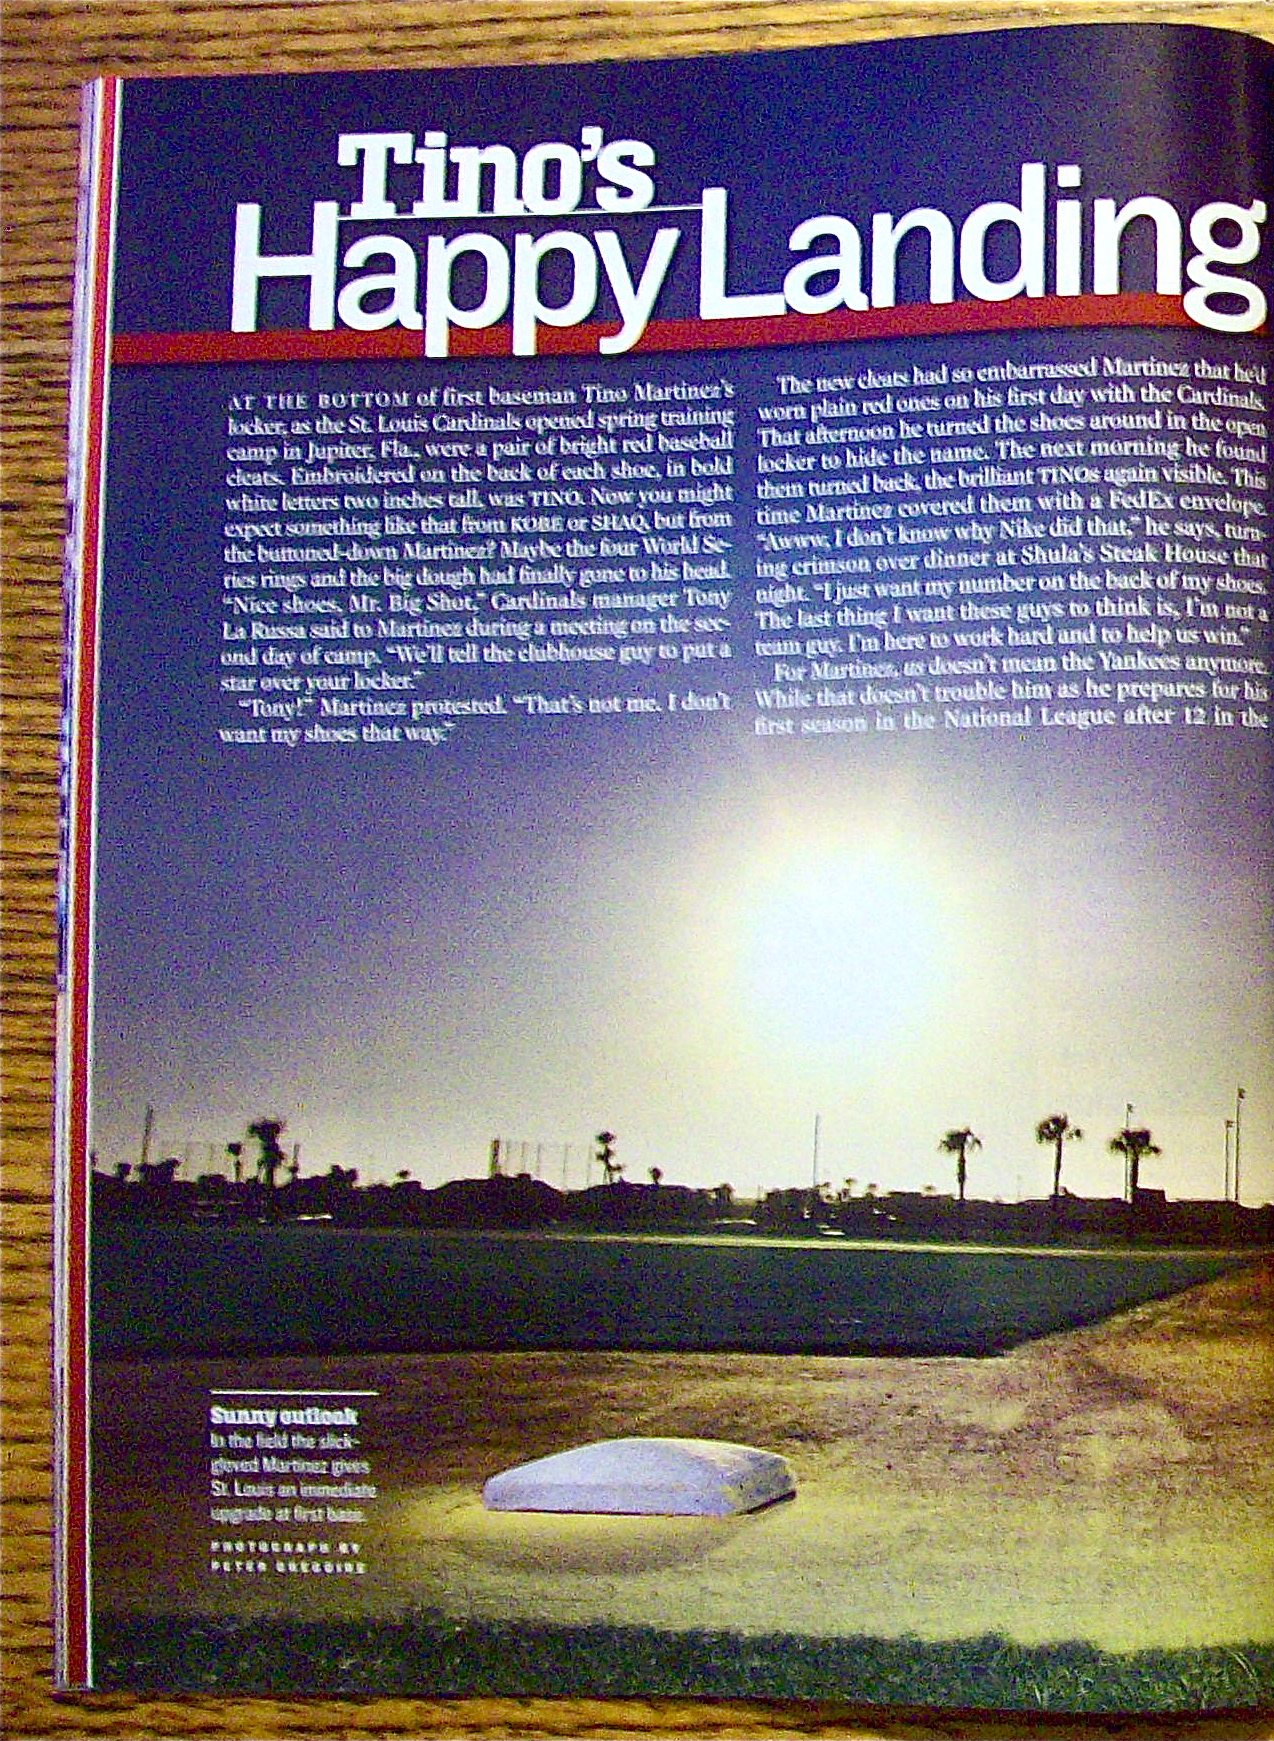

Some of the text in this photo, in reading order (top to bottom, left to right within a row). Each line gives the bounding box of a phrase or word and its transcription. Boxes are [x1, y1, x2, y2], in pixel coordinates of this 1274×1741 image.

[338, 126, 656, 216] Tino's
[232, 162, 1267, 357] Happy Landing
[776, 375, 813, 396] The
[816, 376, 855, 392] new
[858, 368, 909, 389] cleats
[914, 366, 947, 385] had
[951, 369, 972, 383] so
[976, 361, 1097, 380] embarrassed
[1103, 358, 1190, 378] Martinez
[1194, 360, 1229, 380] that
[229, 382, 734, 410] AT THE BOTTOM of first baseman Tino Martinez's
[761, 411, 1267, 449] That afternoon he turned the shoes around in the open
[226, 447, 276, 466] camp
[283, 442, 300, 460] in
[425, 443, 470, 457] were
[475, 444, 487, 457] a
[492, 438, 530, 461] pair
[534, 437, 555, 455] of
[560, 436, 616, 460] bright
[622, 435, 652, 453] red
[658, 432, 733, 451] baseball
[757, 452, 816, 475] locker
[821, 453, 841, 470] to
[846, 448, 889, 468] hide
[894, 446, 926, 465] the
[996, 441, 1035, 459] The
[1040, 442, 1084, 457] next
[1090, 438, 1180, 462] morning
[1186, 439, 1210, 458] he
[1215, 441, 1266, 462] found
[225, 494, 277, 512] white
[282, 492, 339, 511] letters
[344, 493, 379, 509] two
[383, 490, 444, 509] inches
[489, 493, 524, 507] was
[591, 486, 635, 504] Now
[637, 490, 671, 508] you
[678, 484, 733, 507] might
[223, 571, 255, 589] ries
[261, 570, 305, 593] rings
[309, 569, 345, 587] and
[350, 569, 380, 587] the
[383, 568, 411, 591] big
[416, 567, 475, 591] dough
[479, 567, 513, 585] had
[520, 565, 574, 589] finally
[579, 569, 625, 588] gone
[629, 566, 645, 581] to
[651, 563, 679, 581] his
[756, 544, 1267, 584] ing crimson over dinner at Shula's Steak House that
[755, 707, 1268, 736] first season in the National League after 12 in the
[211, 1406, 359, 1427] Sunny outlook
